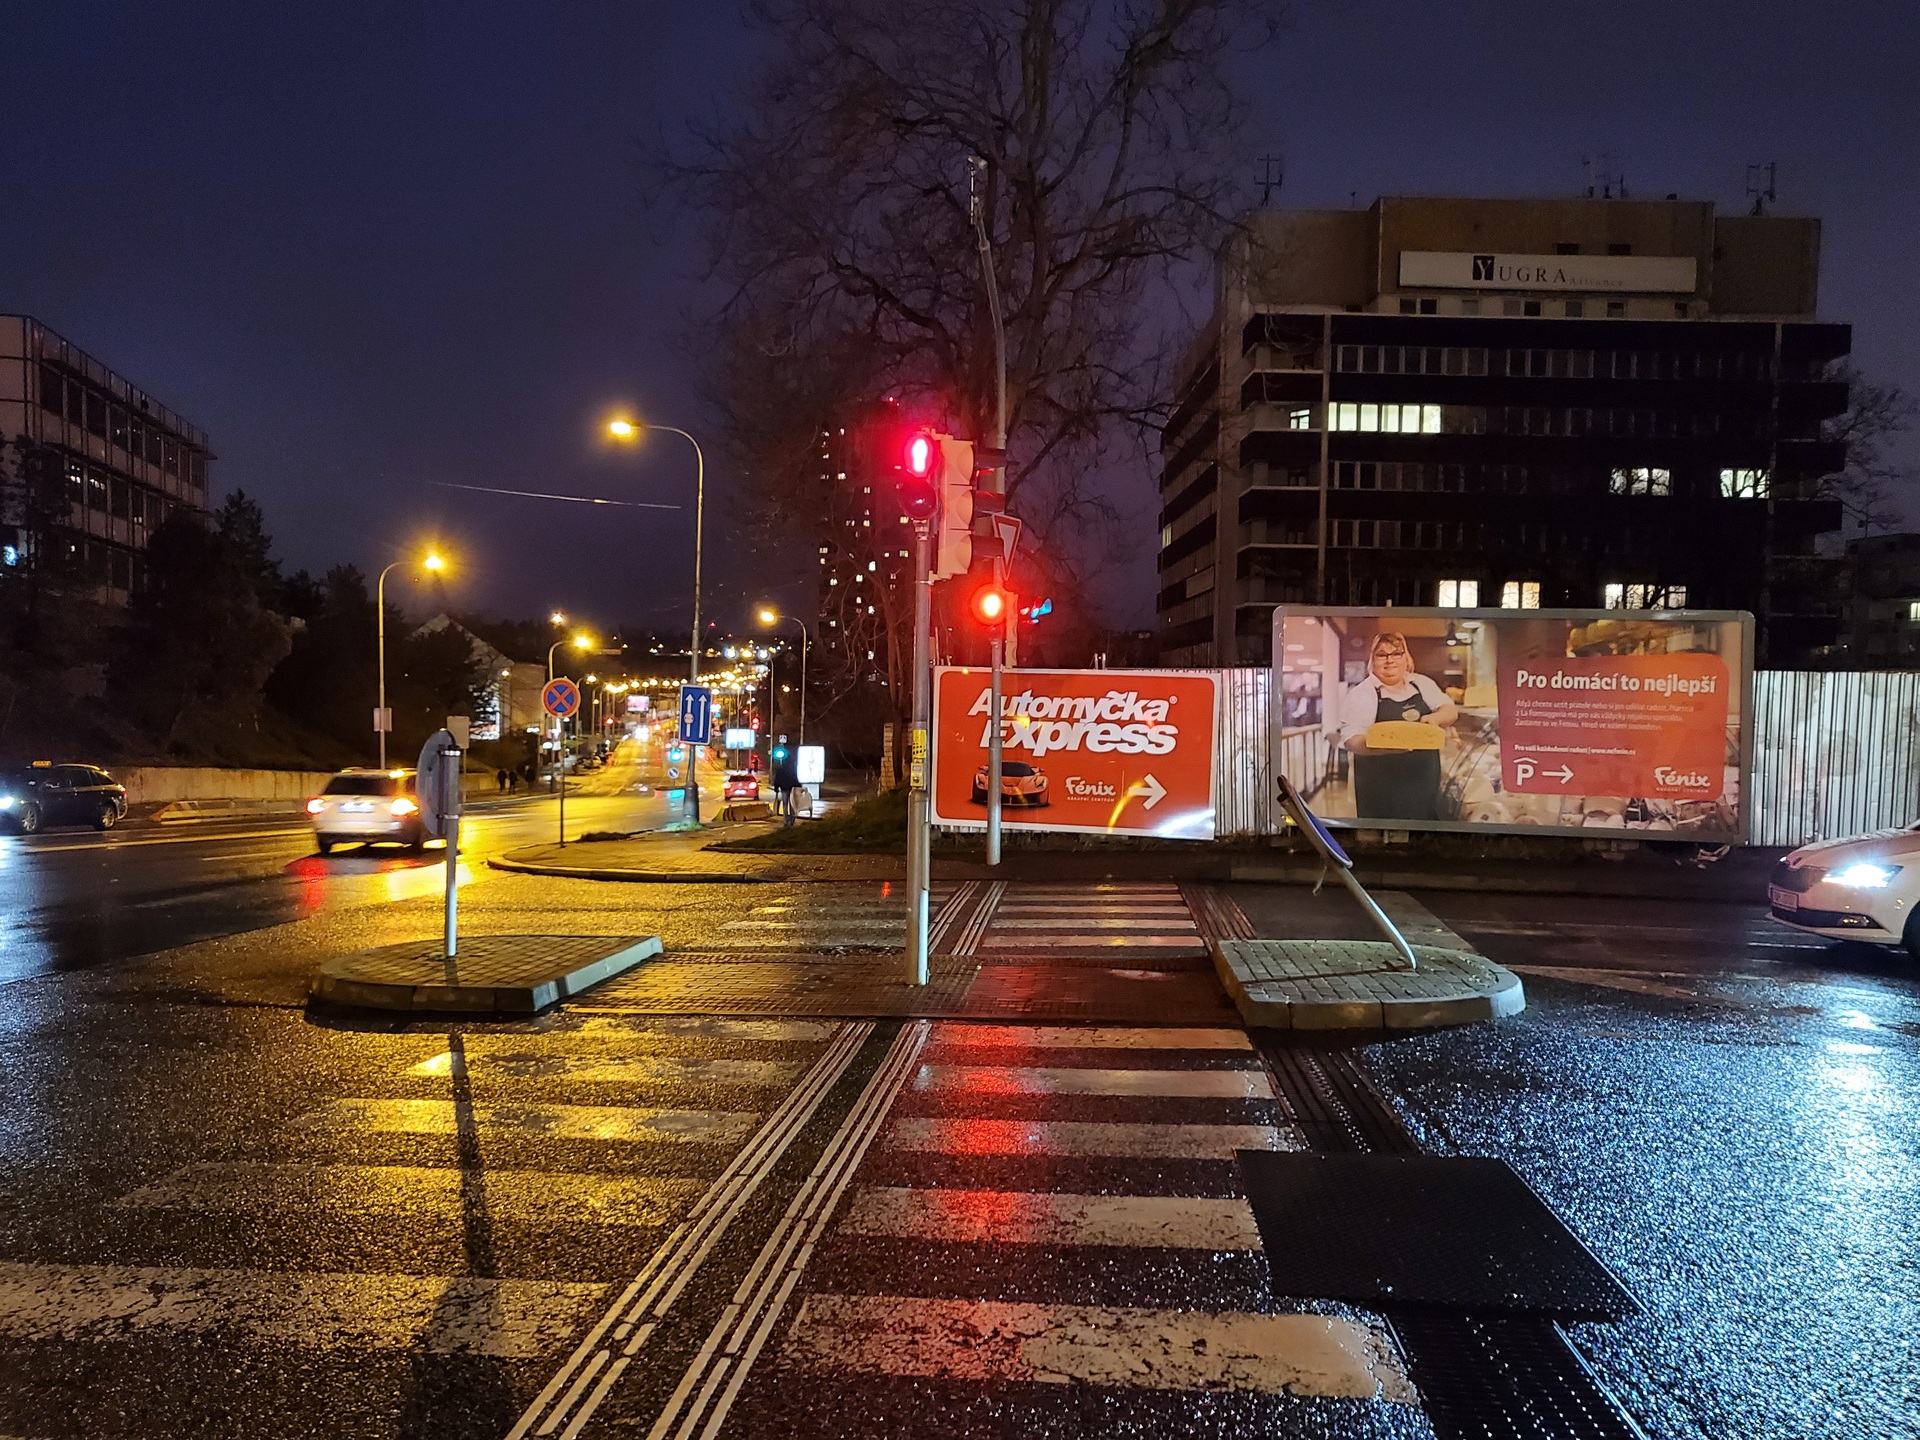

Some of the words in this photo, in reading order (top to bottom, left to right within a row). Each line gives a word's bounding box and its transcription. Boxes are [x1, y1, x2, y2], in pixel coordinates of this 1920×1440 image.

[1475, 257, 1566, 283] YUGRA
[1516, 670, 1547, 688] Pro
[1551, 670, 1618, 690] domácí
[1620, 675, 1640, 691] to
[1644, 673, 1717, 697] nejlepší
[980, 719, 1178, 756] Express
[1065, 776, 1116, 796] Fénix
[1654, 766, 1711, 787] Fénix
